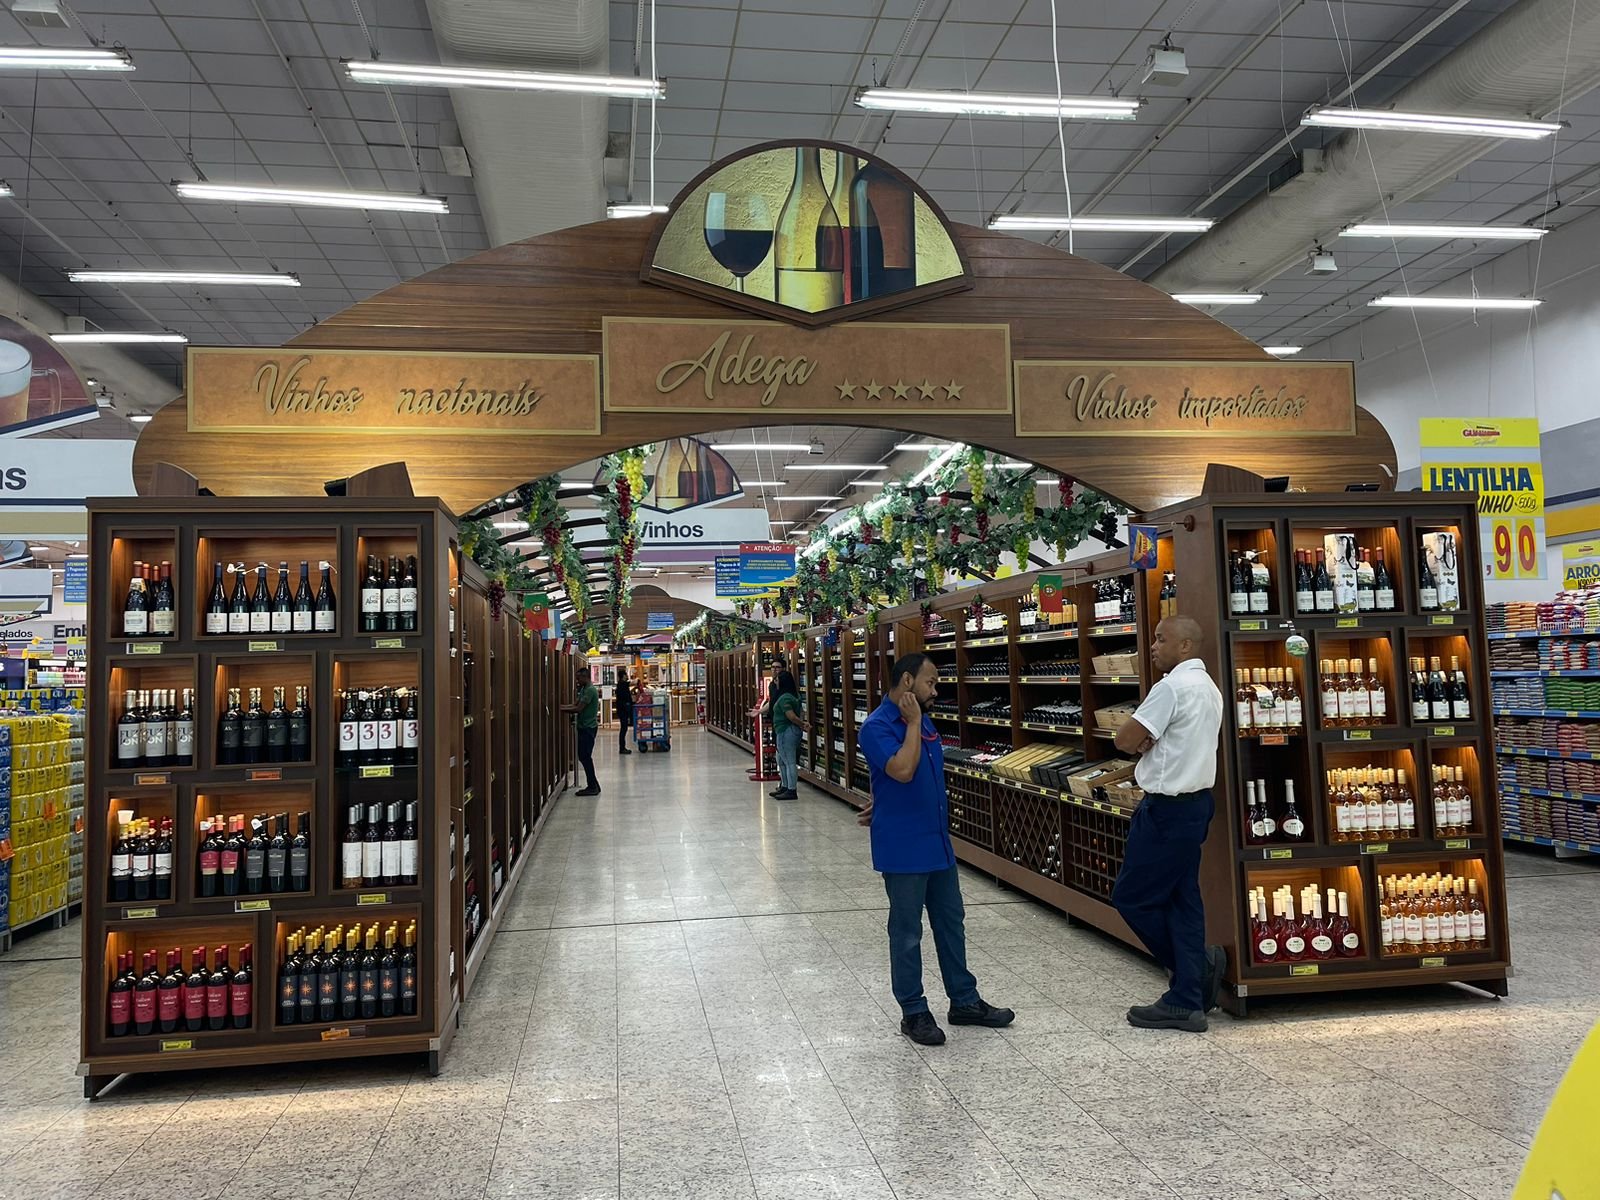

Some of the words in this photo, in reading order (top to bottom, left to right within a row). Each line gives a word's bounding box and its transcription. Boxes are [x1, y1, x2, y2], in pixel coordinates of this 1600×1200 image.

[656, 331, 817, 406] Adega
[252, 355, 364, 415] Vinhos
[395, 377, 541, 416] nacionais
[1065, 372, 1157, 422] Vinhos
[1430, 467, 1535, 492] LENTILHA
[343, 724, 354, 741] 3
[363, 724, 374, 740] 3
[381, 723, 392, 740] 3
[408, 722, 418, 738] 3
